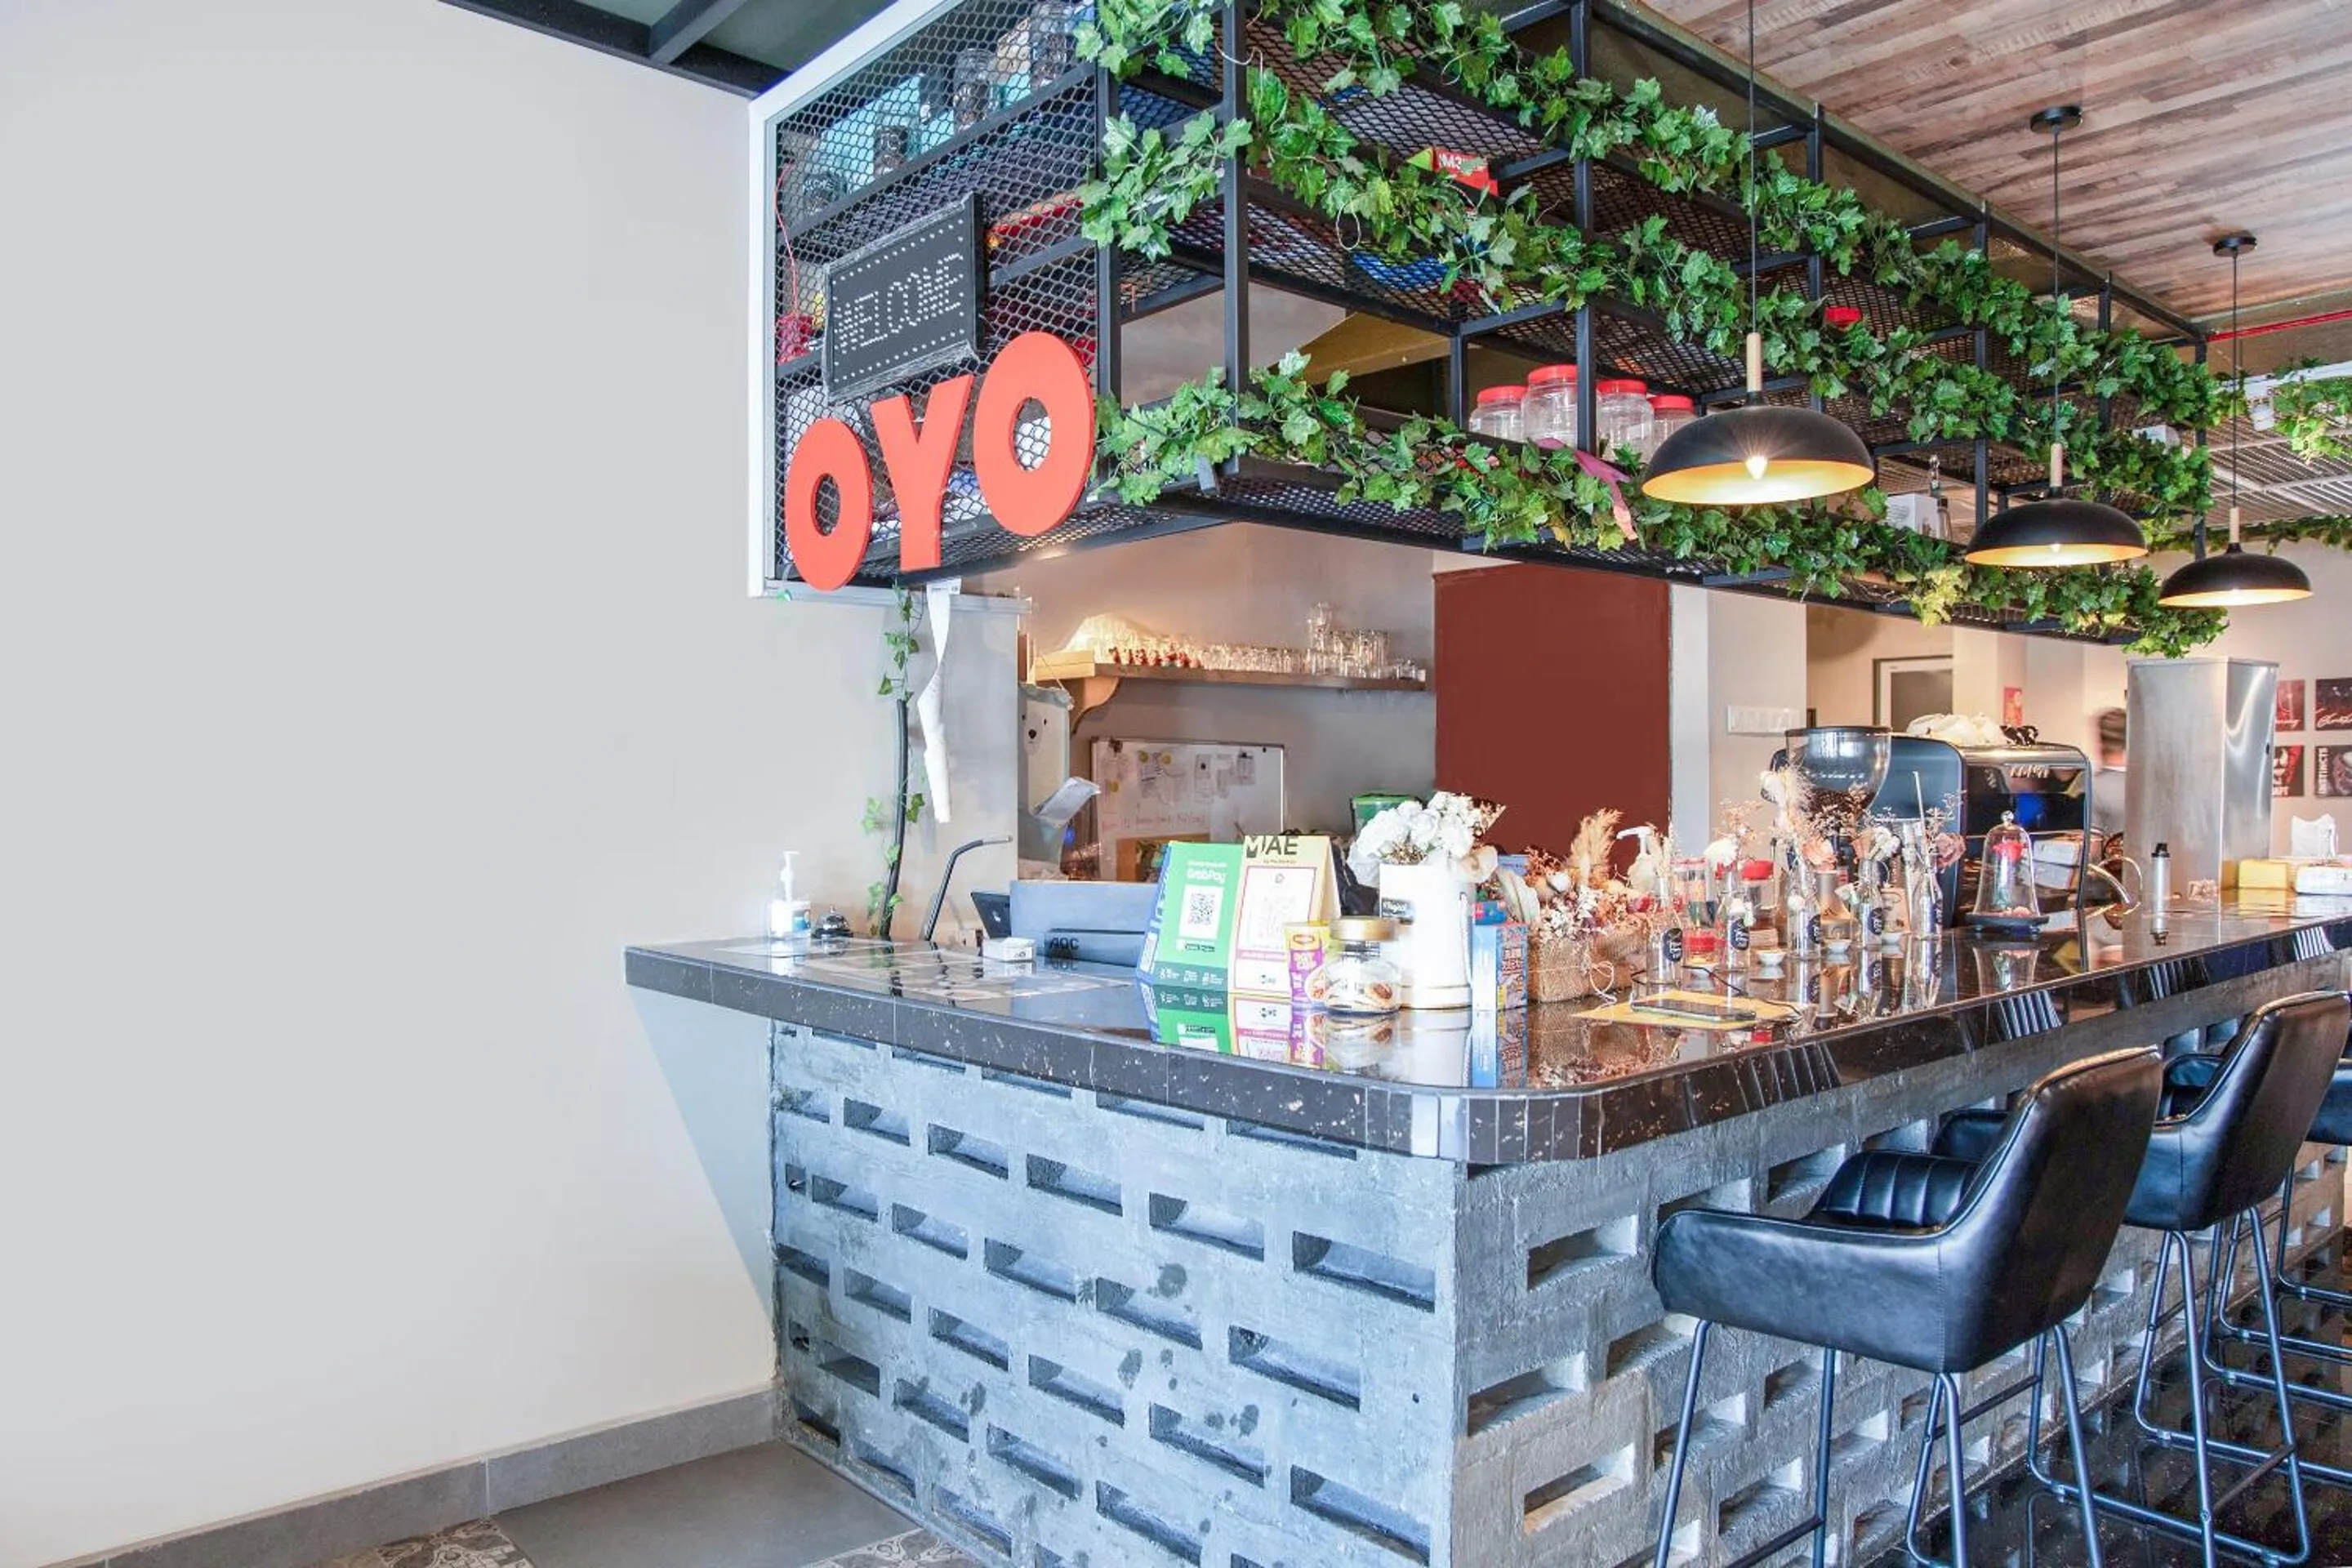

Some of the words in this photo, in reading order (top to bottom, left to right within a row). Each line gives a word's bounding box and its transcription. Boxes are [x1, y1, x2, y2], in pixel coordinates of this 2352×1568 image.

[836, 252, 961, 354] WELCOME
[785, 331, 1095, 591] OYO
[1186, 868, 1227, 884] GrabPay
